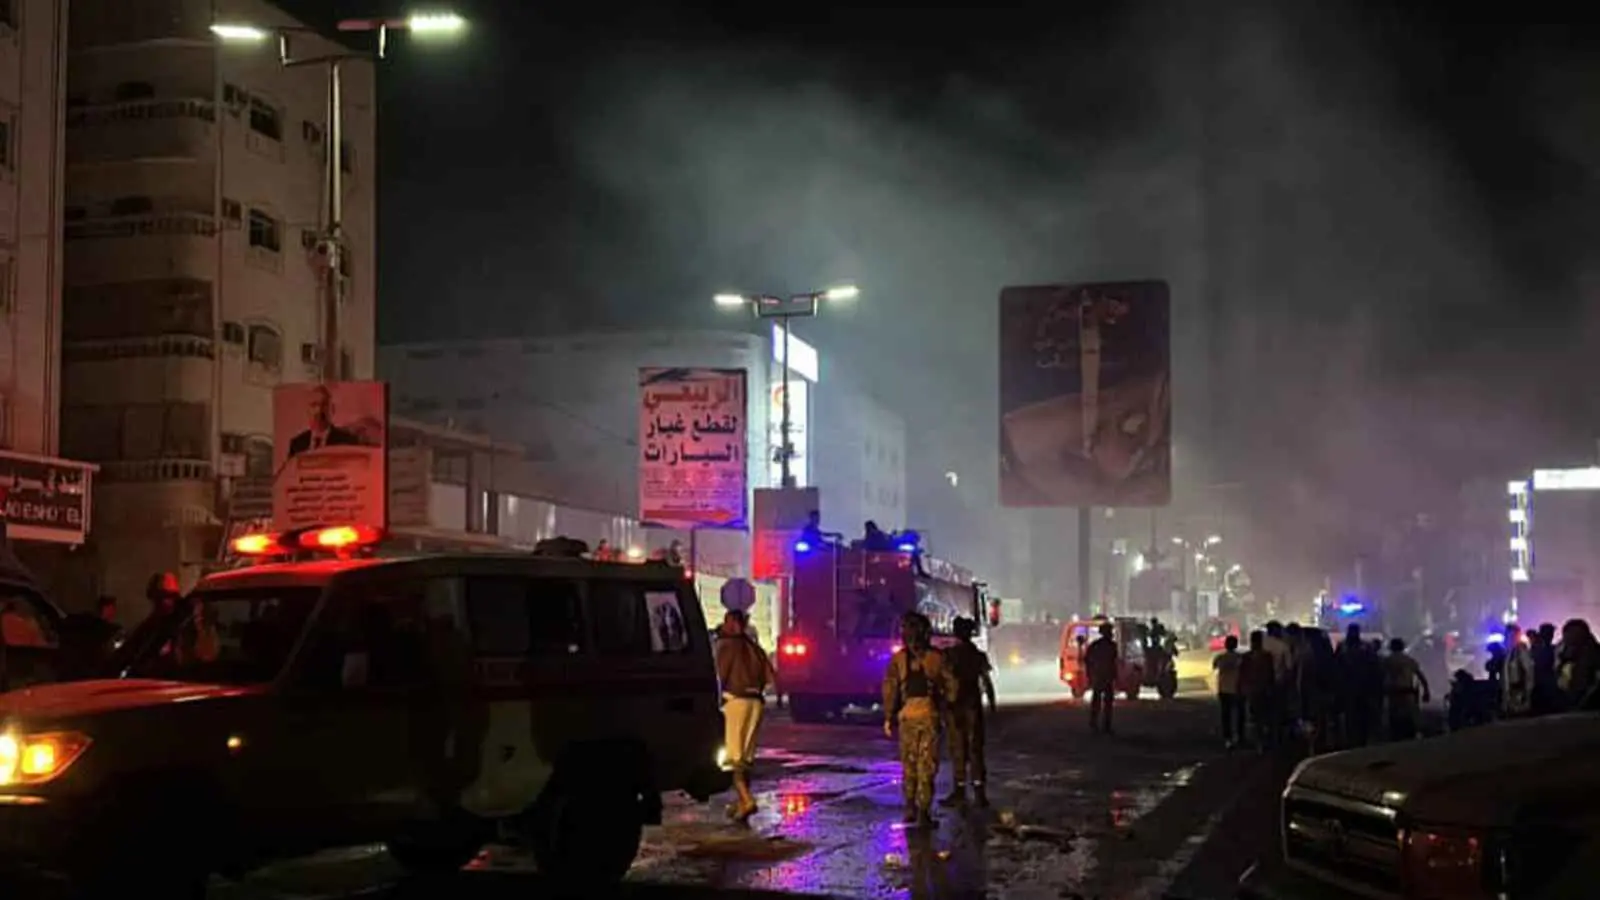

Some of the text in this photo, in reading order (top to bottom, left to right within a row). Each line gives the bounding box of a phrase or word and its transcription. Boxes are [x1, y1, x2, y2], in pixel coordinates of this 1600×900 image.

[646, 413, 686, 439] غيار
[691, 413, 737, 442] لقطع
[644, 441, 738, 467] السيارات
